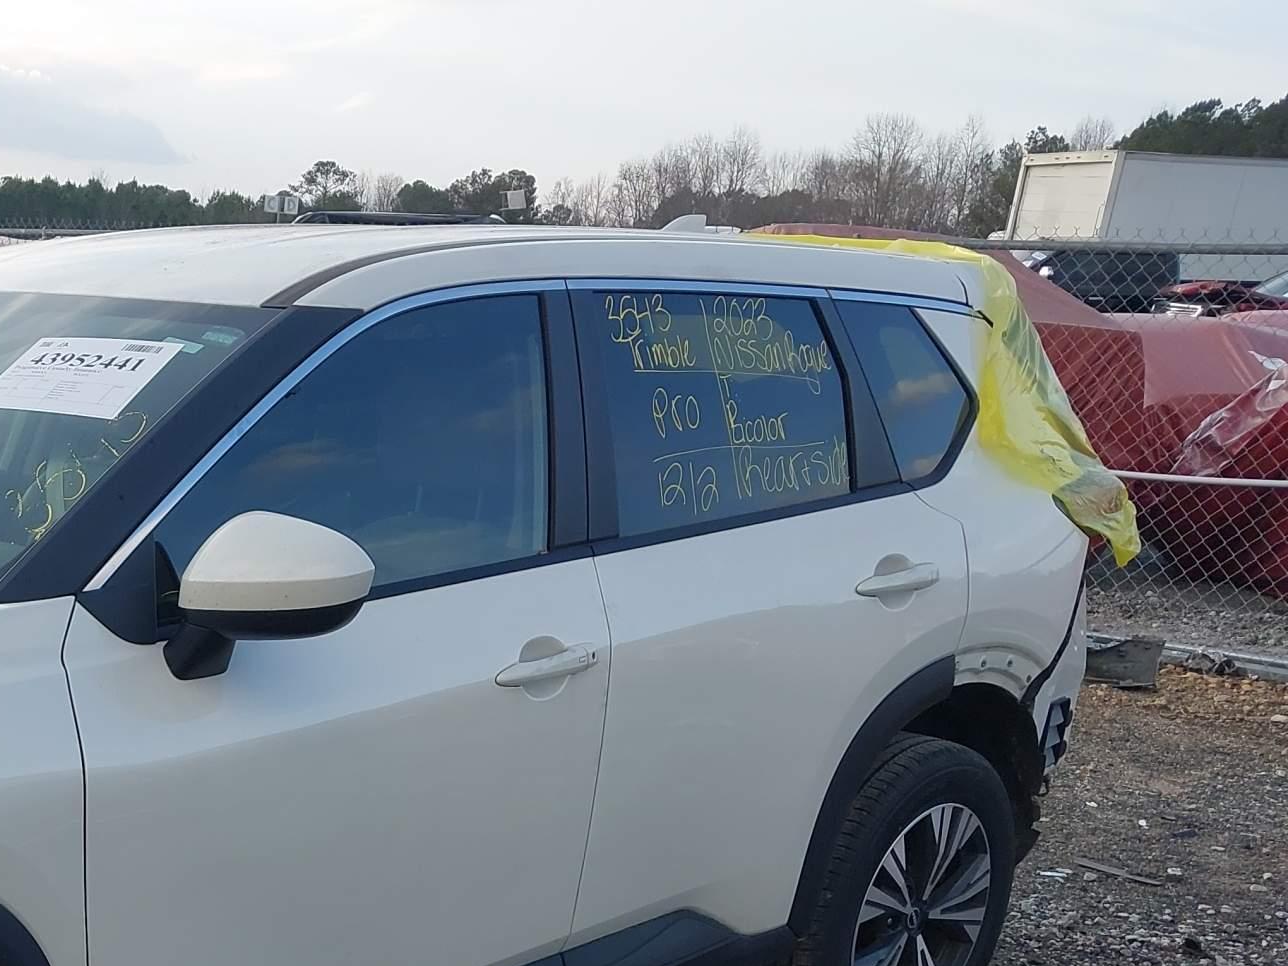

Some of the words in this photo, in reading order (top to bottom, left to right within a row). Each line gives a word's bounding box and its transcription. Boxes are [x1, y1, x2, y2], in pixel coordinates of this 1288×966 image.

[605, 294, 672, 342] 3543
[713, 295, 773, 341] 2023
[30, 351, 146, 373] 43952441
